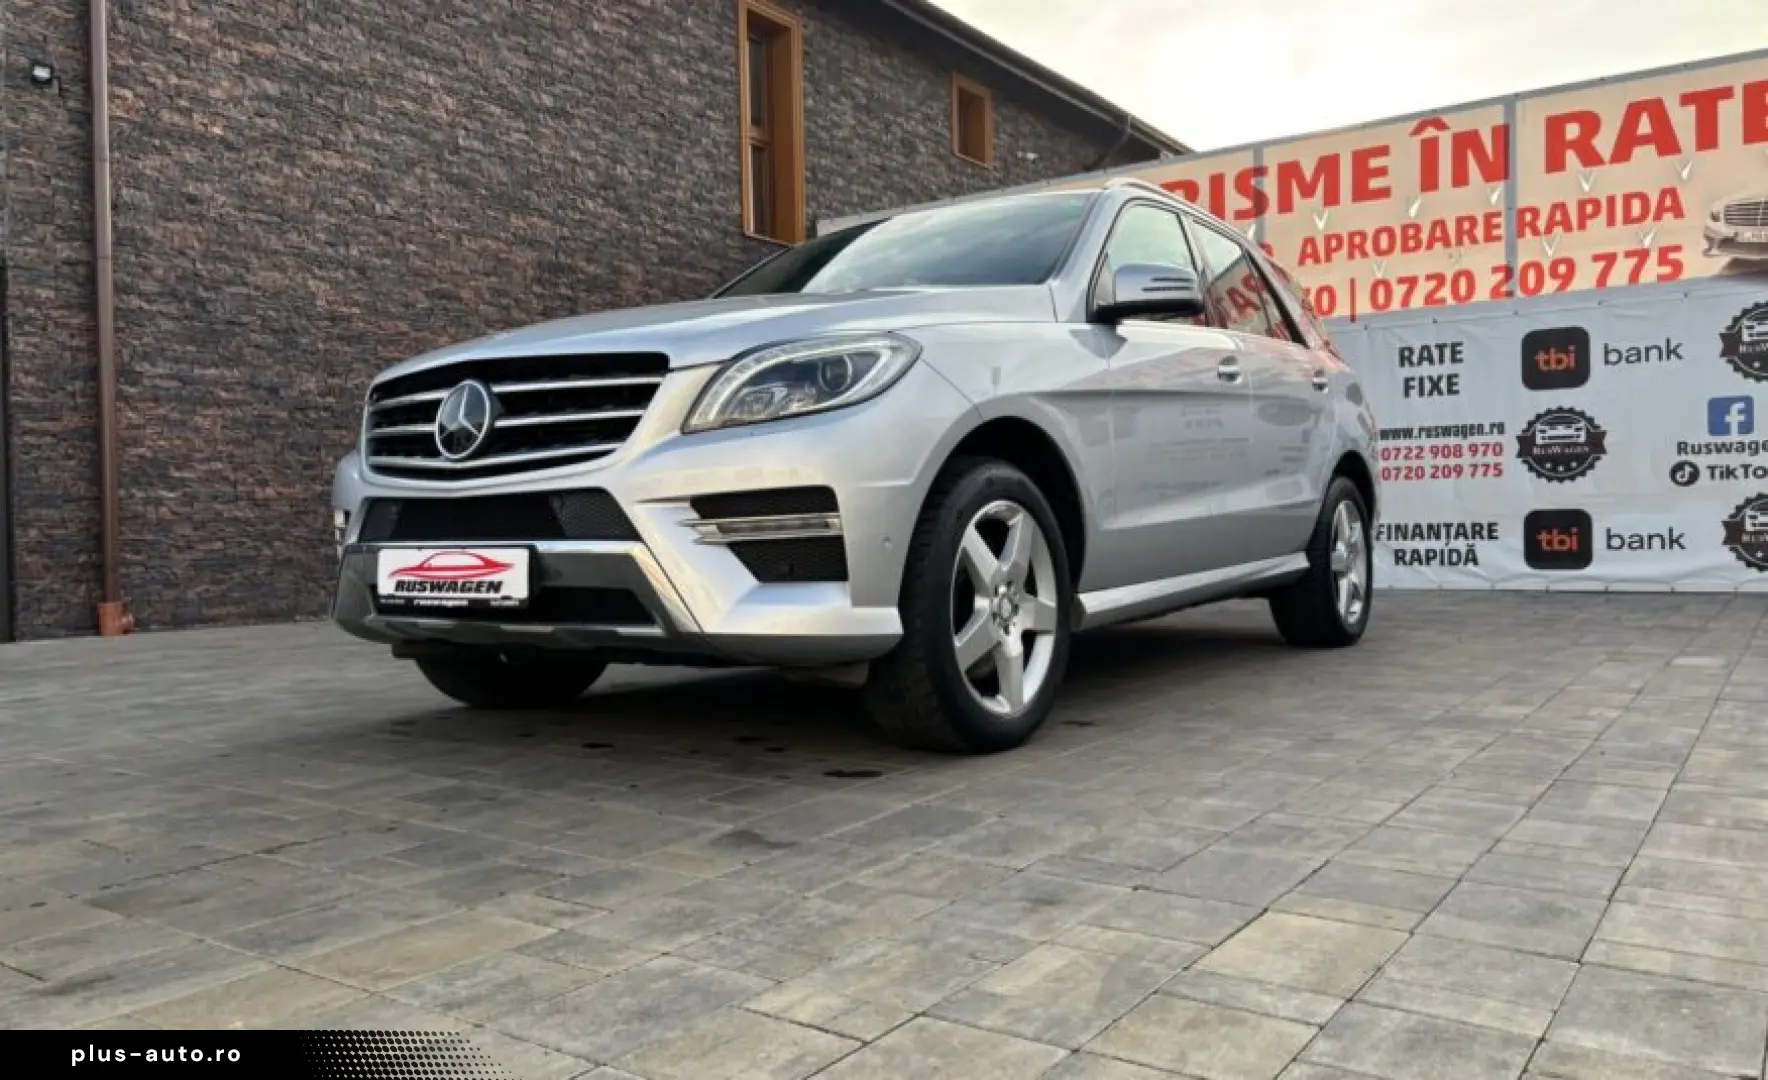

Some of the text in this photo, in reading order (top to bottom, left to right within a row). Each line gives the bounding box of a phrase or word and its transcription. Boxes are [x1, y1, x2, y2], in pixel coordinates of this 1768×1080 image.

[1159, 145, 1391, 222] ISME
[1409, 117, 1510, 192] ÎN
[1297, 187, 1685, 267] APROBARE RAPIDA
[1369, 268, 1477, 313] 0720
[1490, 256, 1576, 298] 209
[1591, 244, 1684, 287] 775
[1399, 341, 1464, 368] RATE
[1535, 344, 1577, 371] tbi
[1603, 337, 1684, 366] bank
[1404, 373, 1460, 398] FIXE
[1381, 442, 1504, 461] 0722 908 970
[1382, 462, 1503, 481] 0720 209 775
[1706, 463, 1768, 480] TikTo
[1536, 527, 1579, 551] tbi
[1606, 527, 1686, 550] bank
[1394, 543, 1479, 566] RAPIDĂ
